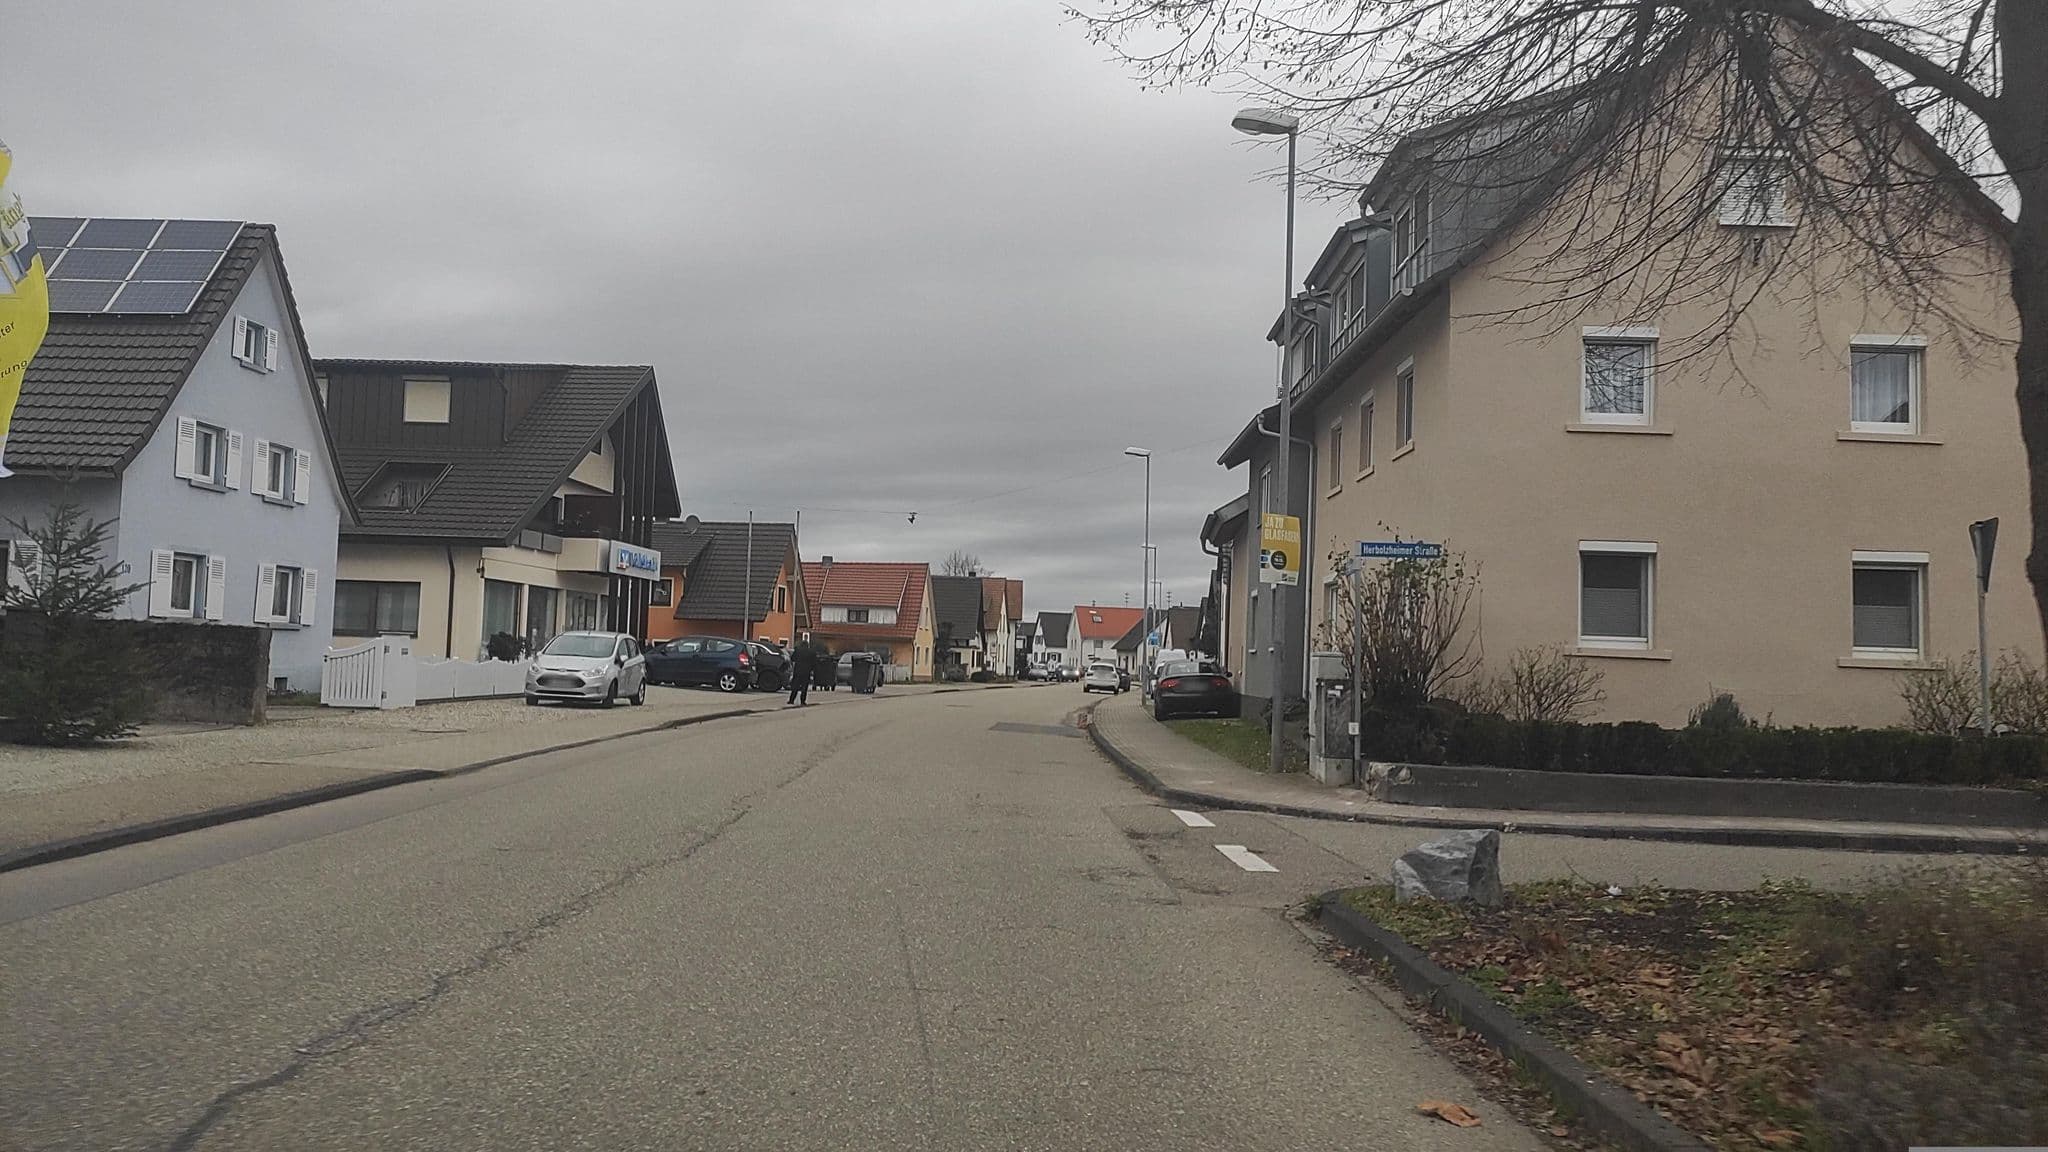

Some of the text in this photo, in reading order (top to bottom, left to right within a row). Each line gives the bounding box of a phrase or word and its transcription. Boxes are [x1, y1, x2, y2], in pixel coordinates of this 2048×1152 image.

[0, 321, 15, 338] ter
[1363, 544, 1439, 556] Herbolzheimer Straße
